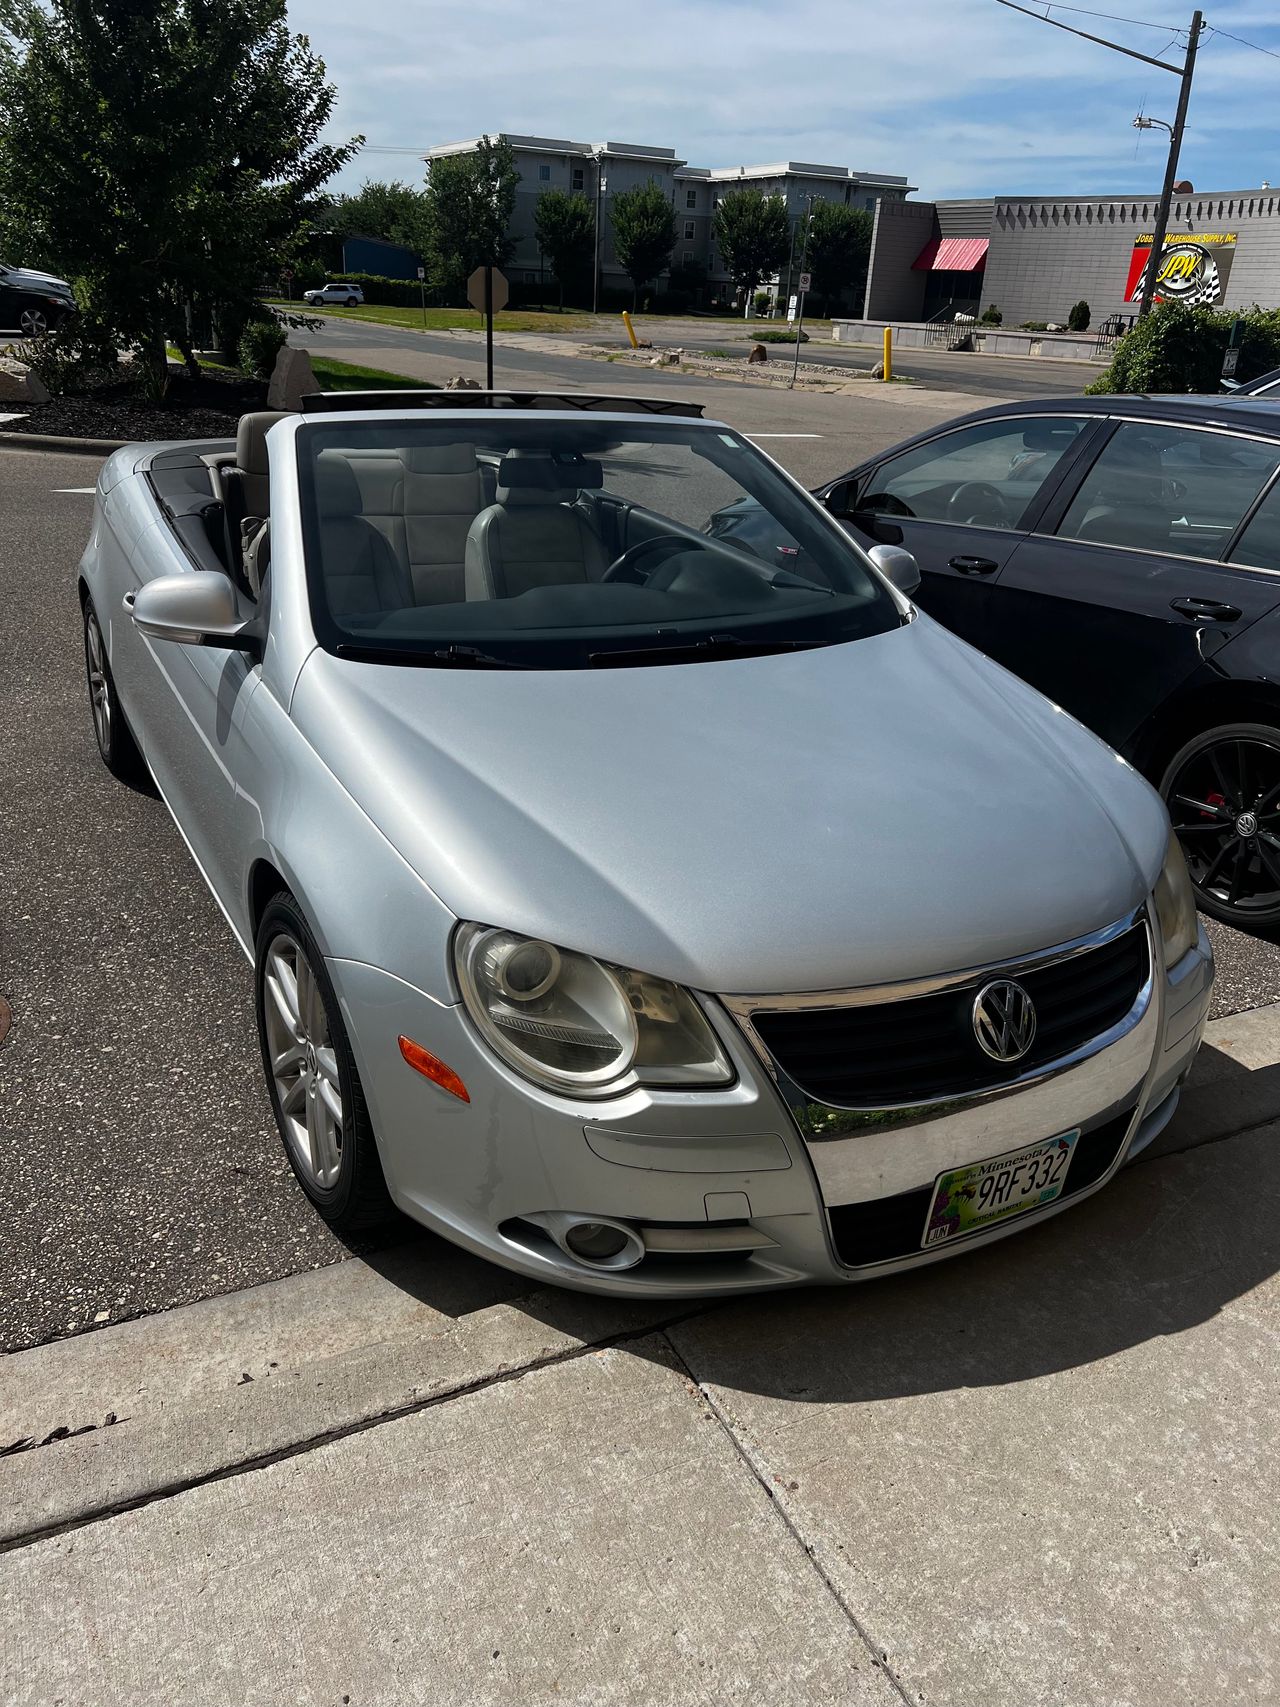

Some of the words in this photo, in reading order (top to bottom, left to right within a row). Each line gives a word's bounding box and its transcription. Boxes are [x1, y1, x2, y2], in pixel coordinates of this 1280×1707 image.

[1164, 233, 1201, 243] WAREHOUSE
[1202, 233, 1224, 245] SUPPLY,
[1156, 255, 1203, 283] JPW
[977, 1149, 1043, 1178] Minnesota
[977, 1149, 1068, 1210] 9RF332
[967, 1211, 996, 1225] CRITICAL
[930, 1226, 947, 1241] JUN
